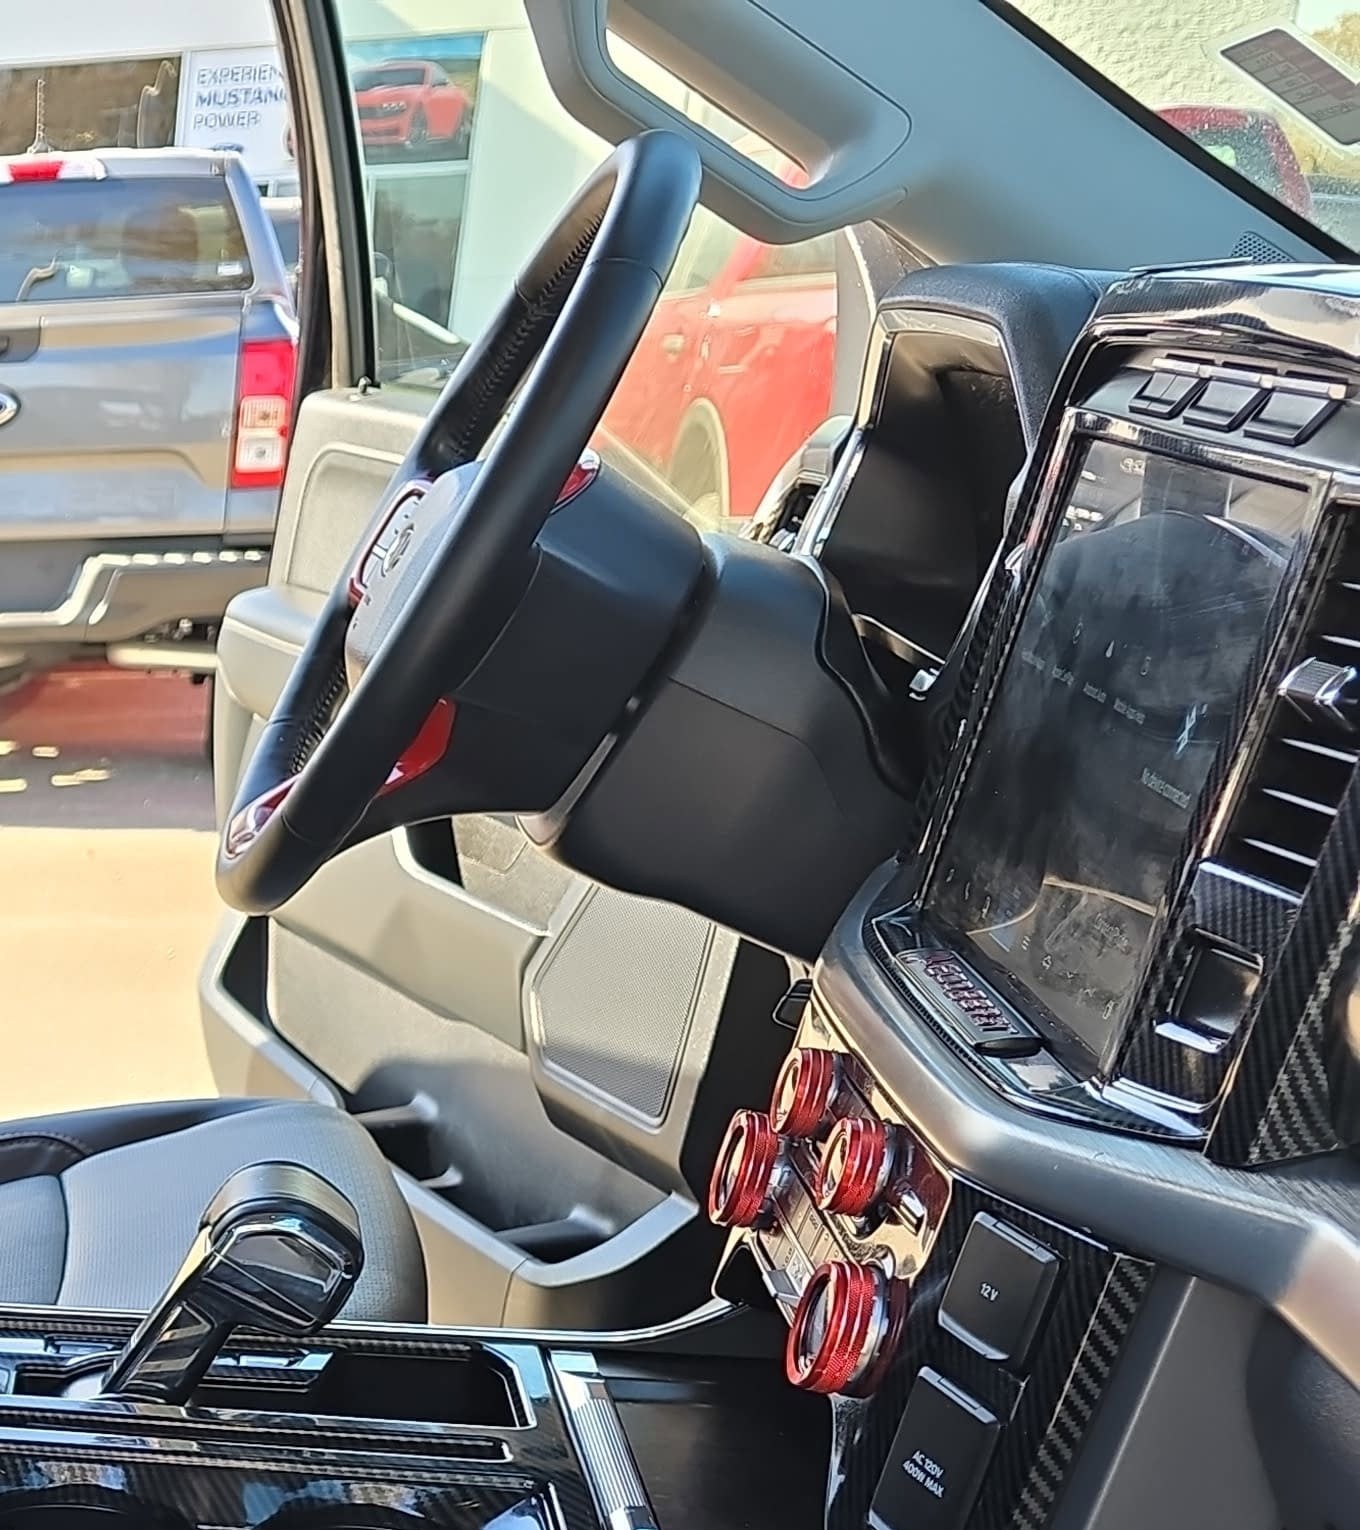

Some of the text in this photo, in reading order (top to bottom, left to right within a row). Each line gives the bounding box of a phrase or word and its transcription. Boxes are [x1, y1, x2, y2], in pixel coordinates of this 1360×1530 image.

[192, 110, 261, 130] POWER
[902, 1460, 945, 1498] 400W MAX
[912, 1450, 945, 1479] AC 120V
